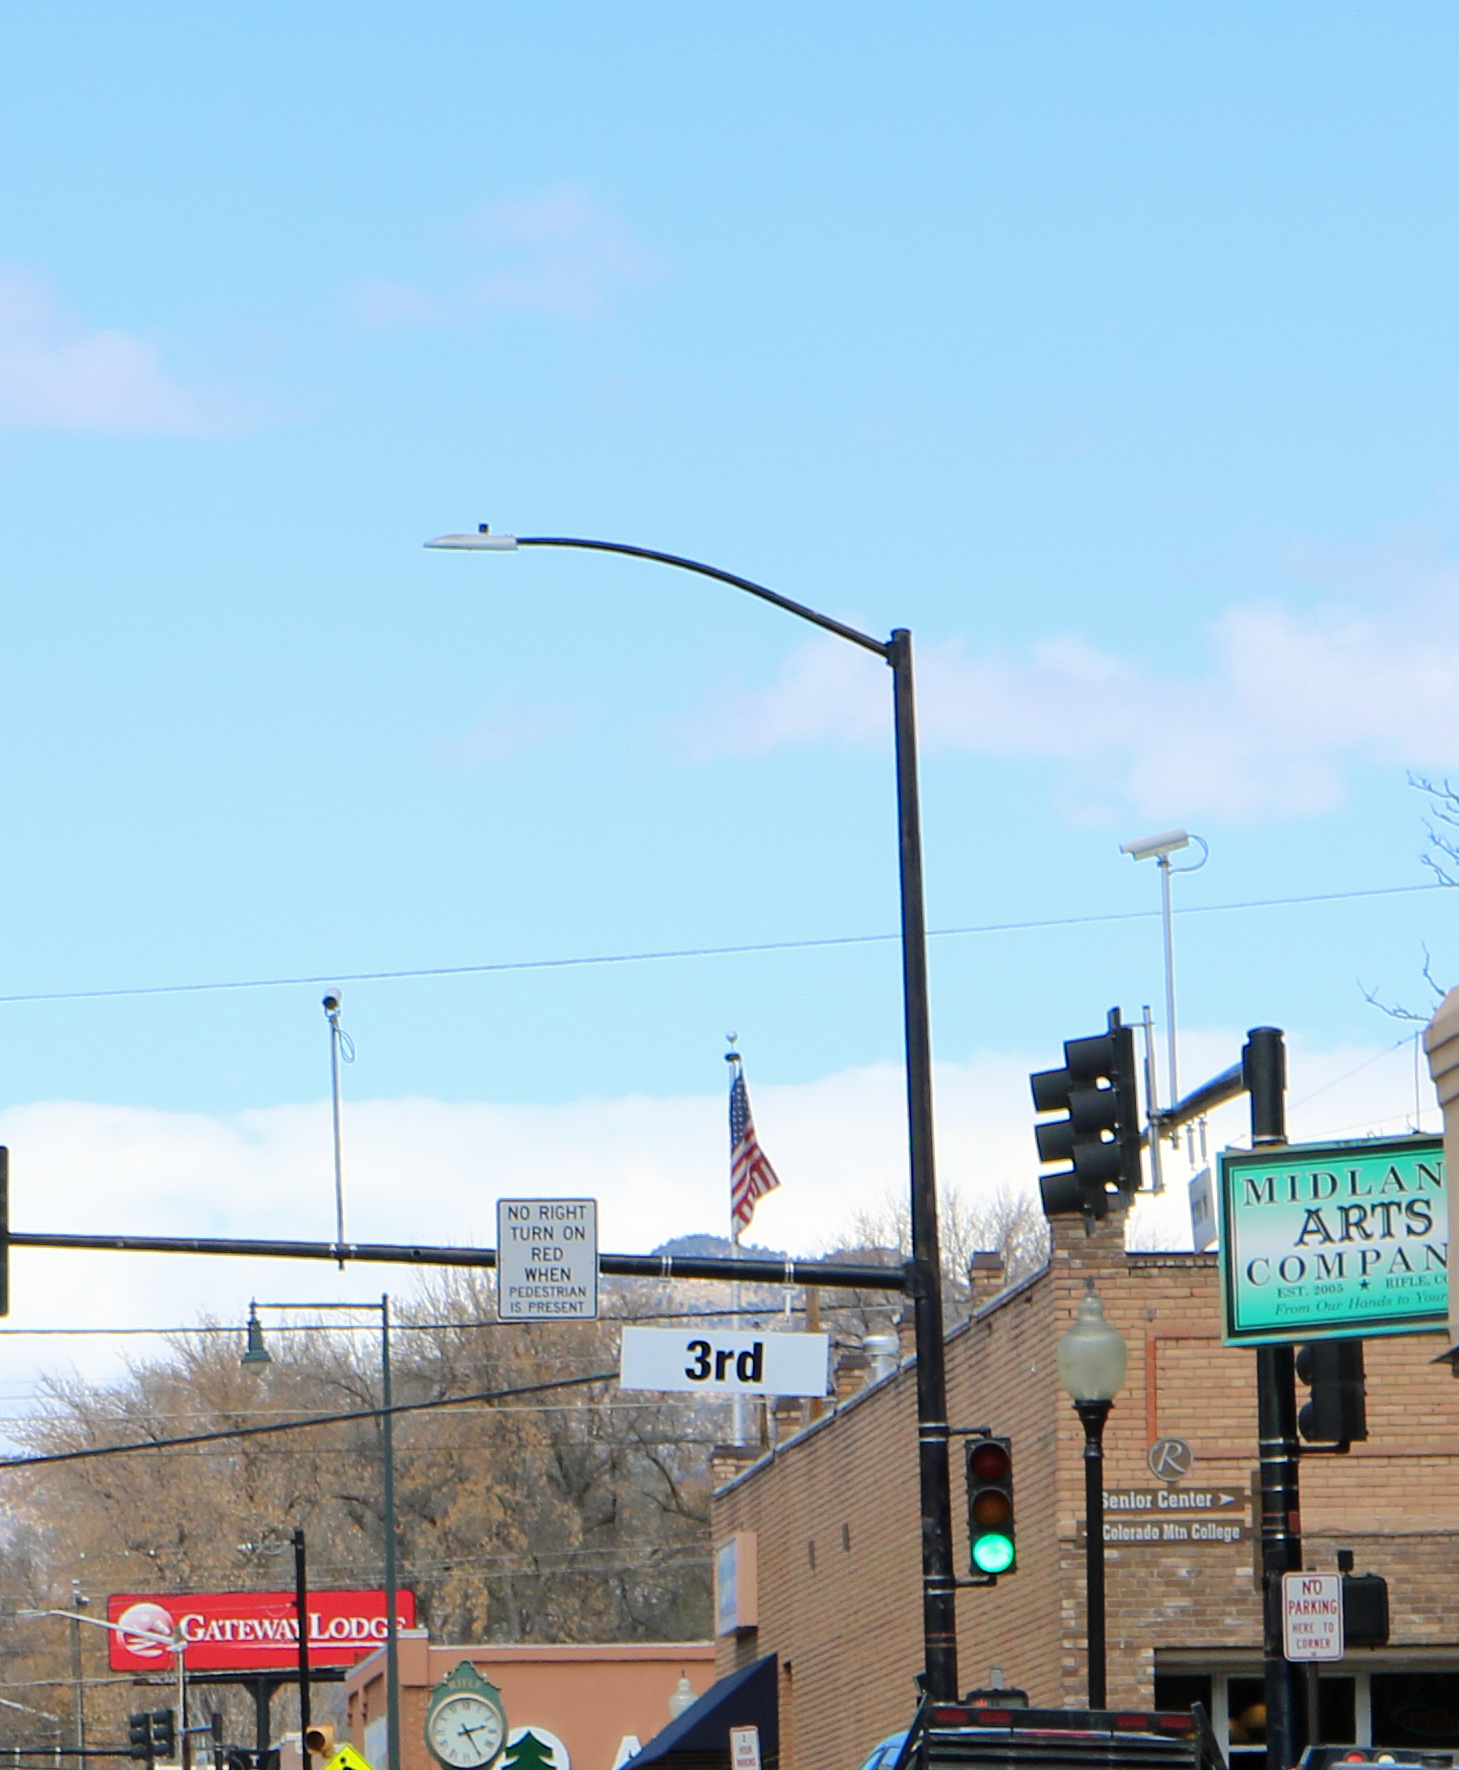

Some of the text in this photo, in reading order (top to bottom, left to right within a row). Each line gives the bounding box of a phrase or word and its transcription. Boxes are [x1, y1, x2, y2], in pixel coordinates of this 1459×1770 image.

[1241, 1160, 1445, 1207] MIDLAN
[508, 1205, 586, 1220] NO RIGHT
[1293, 1199, 1434, 1248] ARTS
[511, 1226, 585, 1241] TURN ON
[531, 1247, 563, 1261] RED
[1246, 1242, 1448, 1287] COMPAN
[524, 1267, 571, 1281] WHEN
[509, 1286, 586, 1298] PEDESTRIAN
[1277, 1286, 1309, 1299] EST.
[1385, 1274, 1431, 1290] RIFLE,
[510, 1301, 584, 1314] IS PRESENT
[1275, 1292, 1448, 1316] From Our Hands to Your
[685, 1341, 764, 1383] 3rd
[1102, 1490, 1213, 1511] Senior Center
[1103, 1523, 1241, 1543] Colorado Mtn College
[1302, 1579, 1323, 1596] NO
[1288, 1600, 1338, 1616] PARKING
[1292, 1622, 1334, 1634] HERE TO
[1296, 1638, 1331, 1650] CORNER
